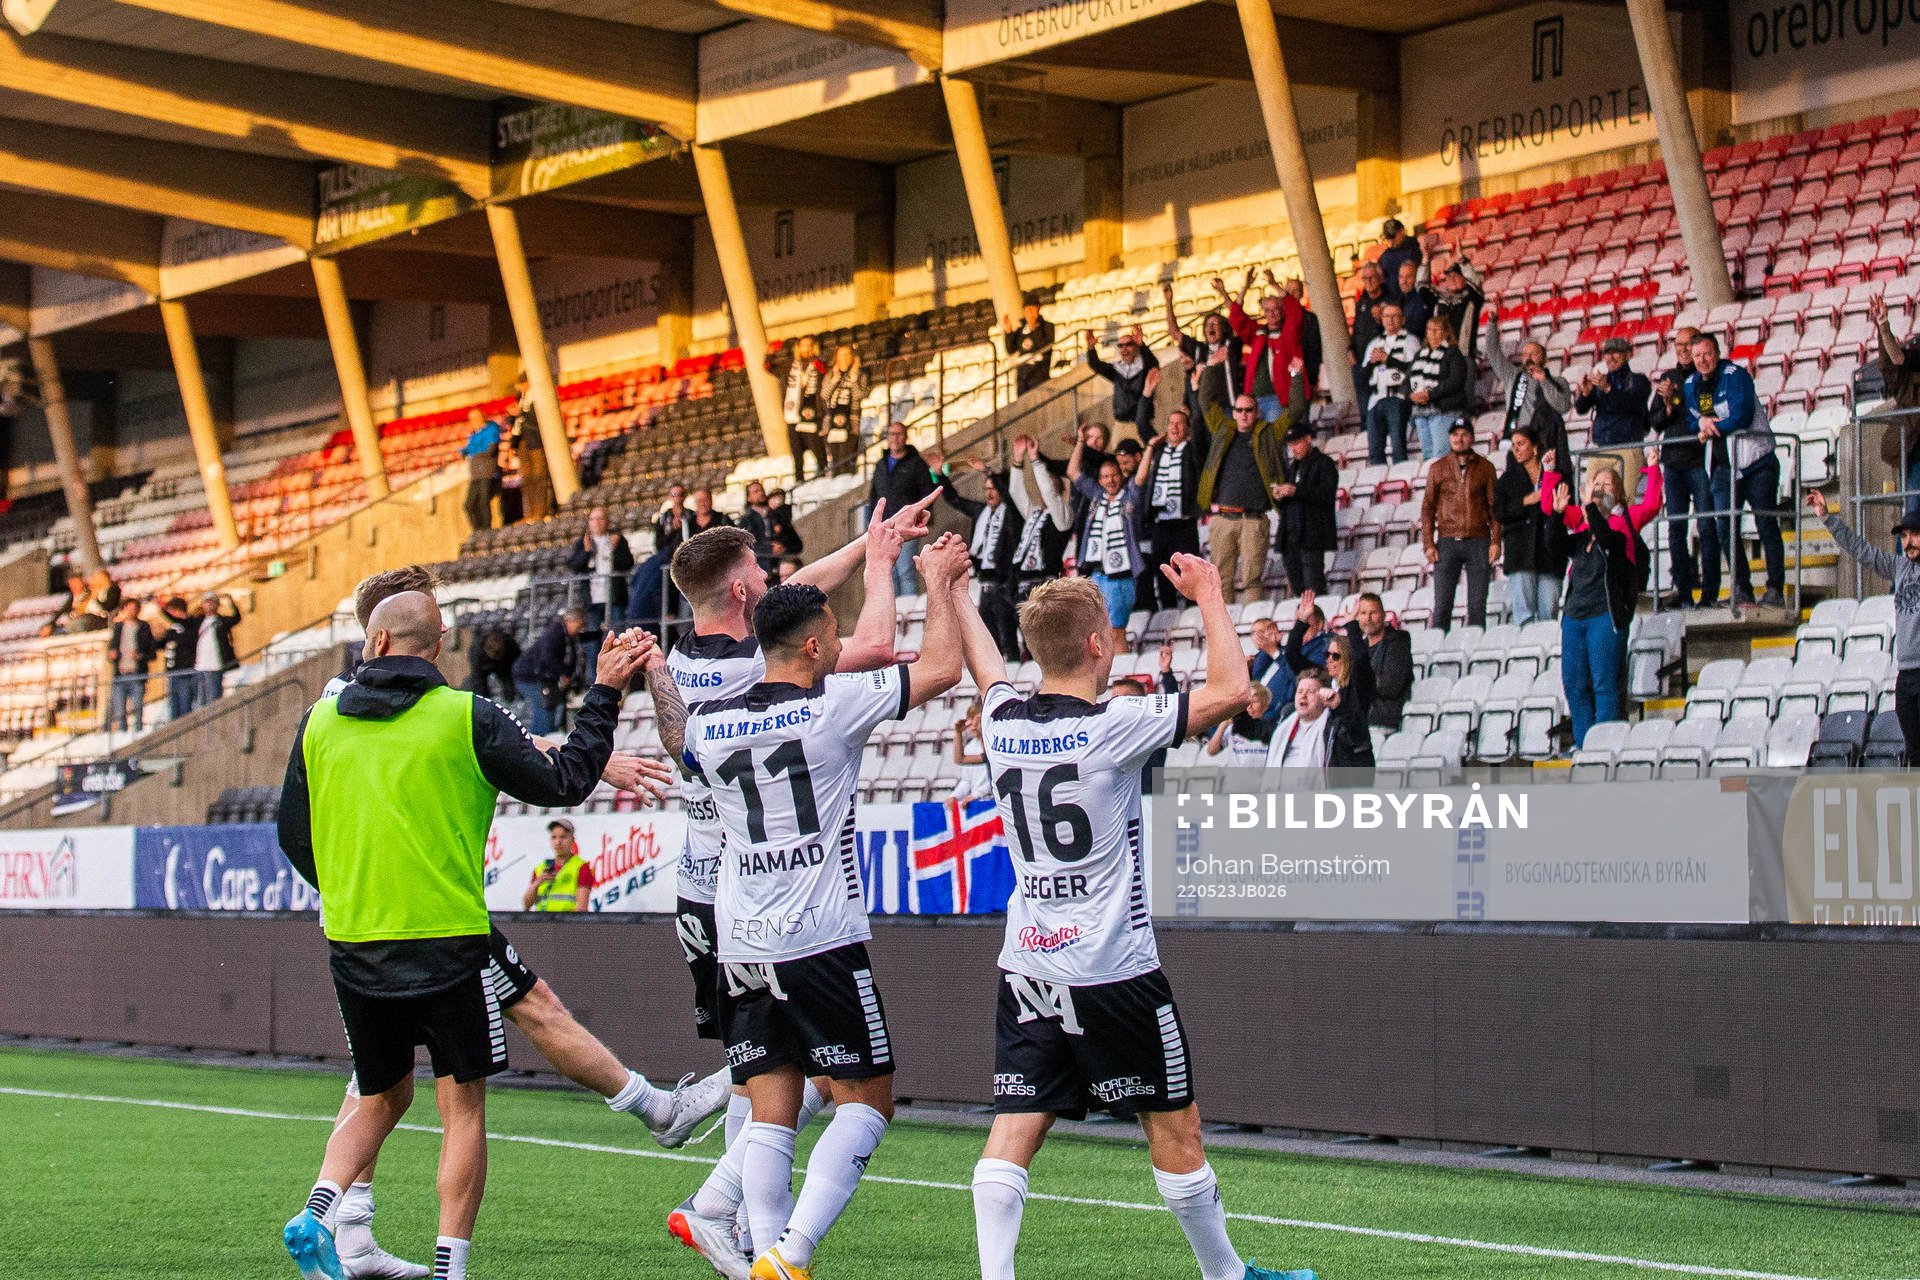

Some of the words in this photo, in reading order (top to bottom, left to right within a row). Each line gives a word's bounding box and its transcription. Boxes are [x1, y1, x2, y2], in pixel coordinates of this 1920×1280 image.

[1440, 85, 1652, 166] ÖREBROPORTE
[716, 739, 821, 844] 11
[995, 763, 1093, 863] 16
[739, 843, 825, 876] HAMAD
[1505, 862, 1651, 884] BYGGNADSTEKNISKA
[1656, 857, 1706, 884] BYRÅN
[1813, 786, 1920, 900] ELO
[203, 846, 260, 911] Care
[1024, 874, 1090, 899] SEGER
[731, 905, 820, 941] ERNST
